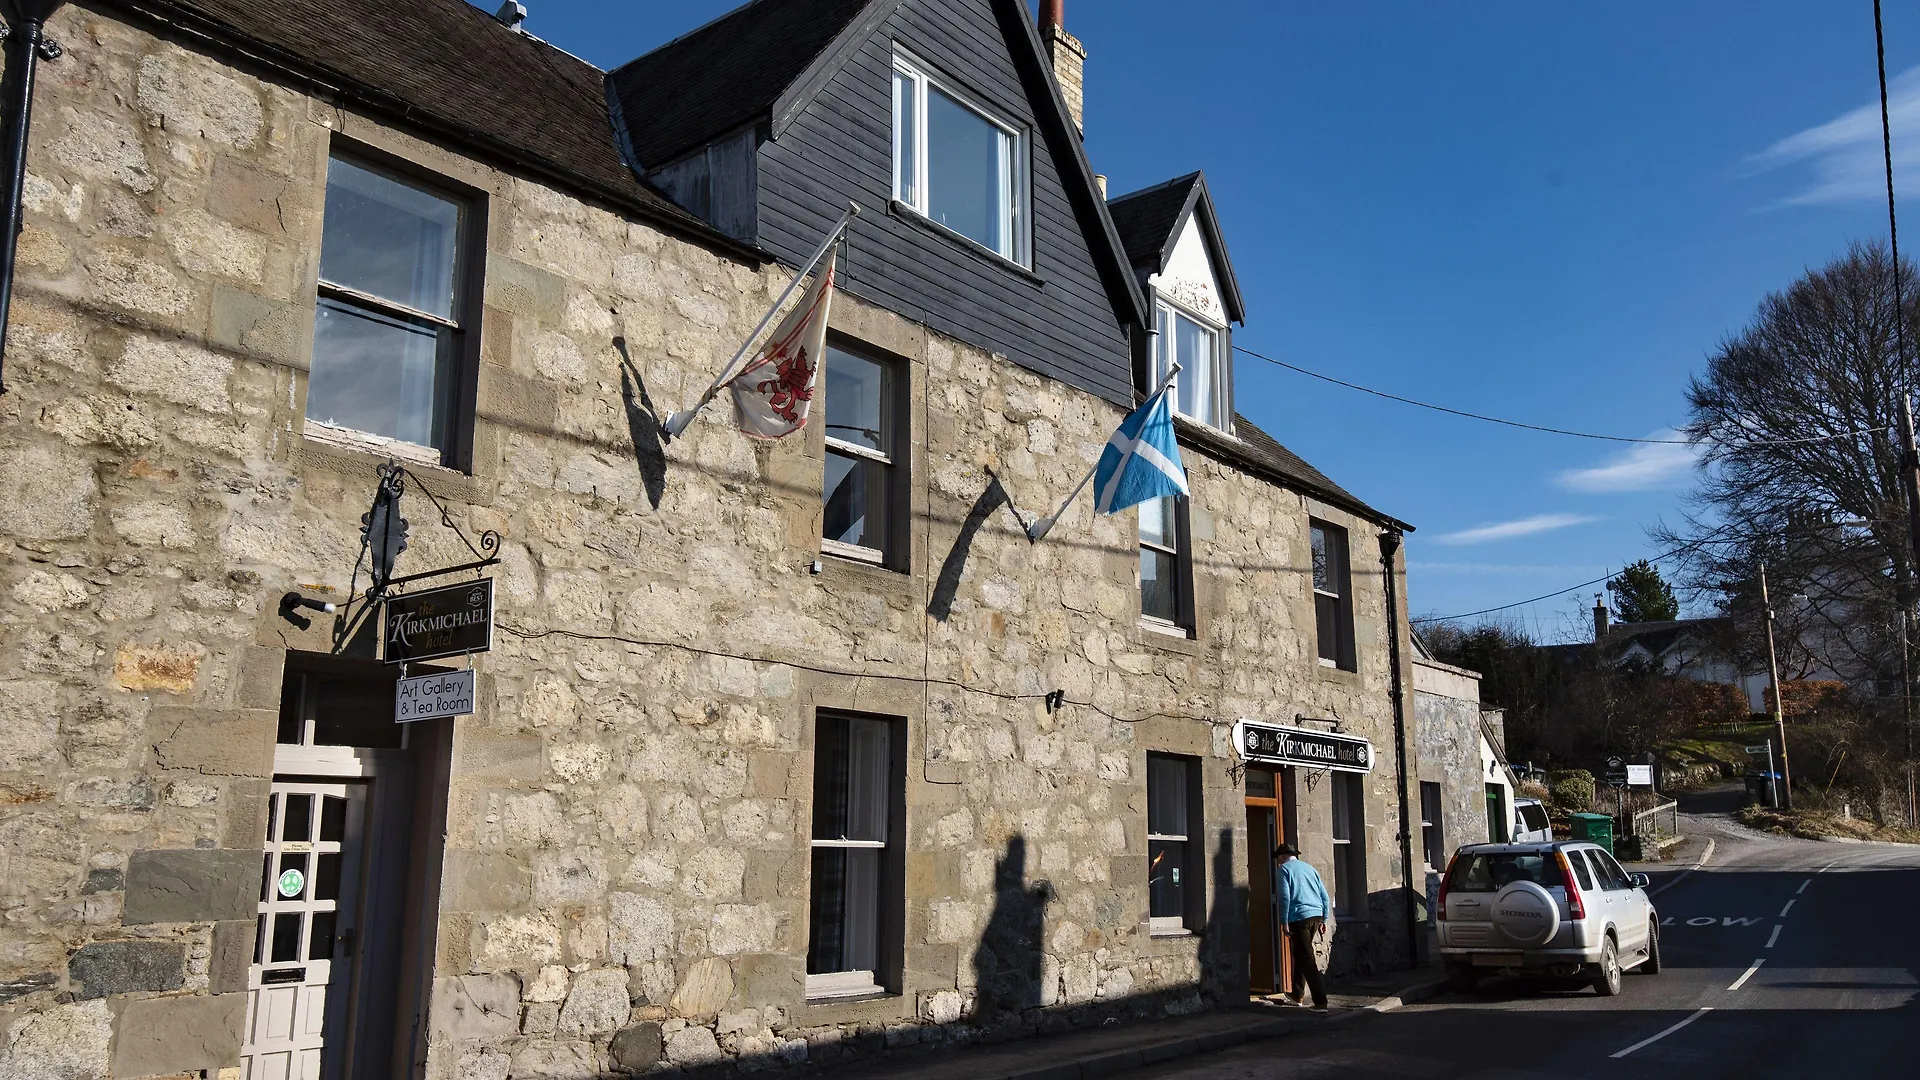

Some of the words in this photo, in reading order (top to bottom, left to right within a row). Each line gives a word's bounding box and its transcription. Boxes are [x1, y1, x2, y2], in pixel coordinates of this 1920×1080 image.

[419, 601, 435, 616] the
[389, 608, 488, 647] KIRKMICHAEL
[426, 629, 453, 649] hotel
[400, 682, 418, 699] Art
[422, 677, 464, 697] Gallery
[401, 702, 409, 715] &
[413, 699, 433, 714] Tea
[436, 697, 469, 712] Room
[1261, 733, 1274, 751] the
[1276, 732, 1337, 761] KIRKMICHAEL
[1338, 743, 1355, 762] hotel
[1500, 909, 1543, 919] HONDA
[1659, 916, 1763, 926] LOW
